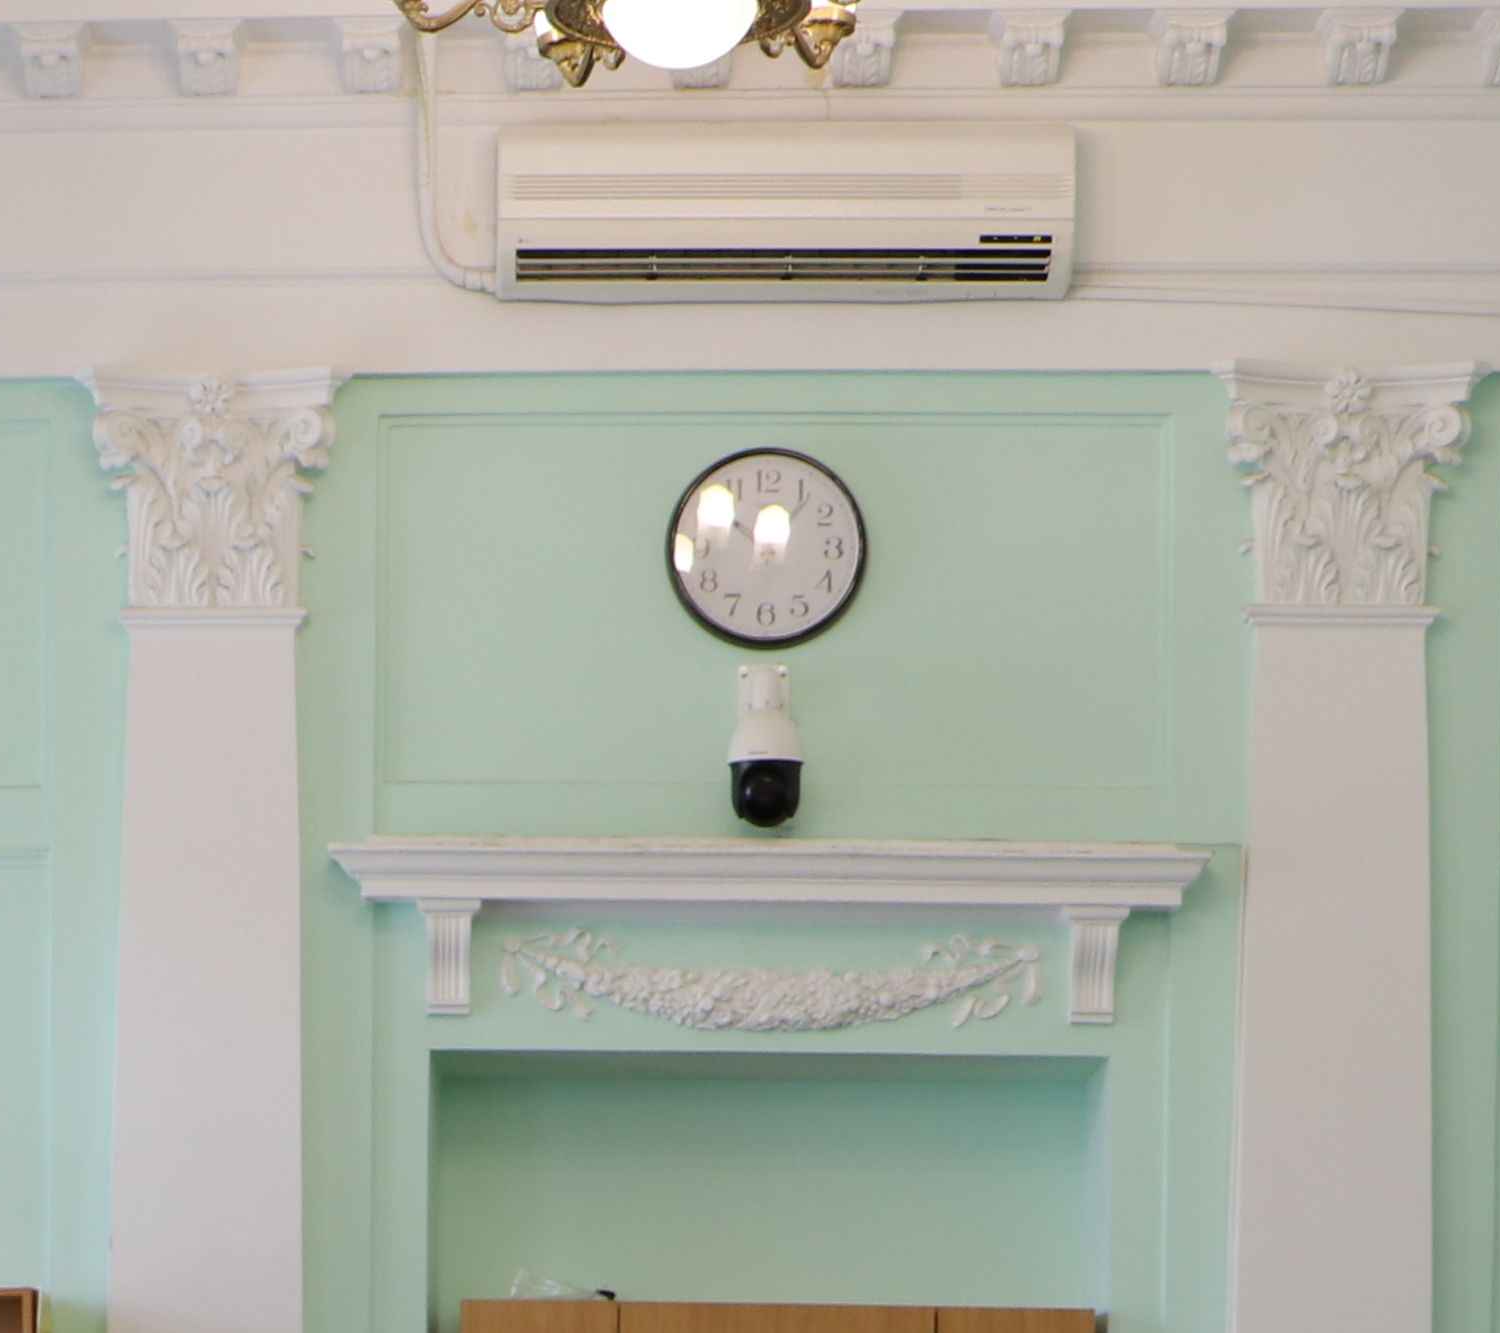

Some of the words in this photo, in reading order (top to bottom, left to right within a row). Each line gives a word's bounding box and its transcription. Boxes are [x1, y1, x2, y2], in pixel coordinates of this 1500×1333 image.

[756, 469, 782, 493] 12
[816, 503, 834, 527] 2
[823, 536, 844, 560] 3
[699, 569, 718, 592] 8
[814, 569, 833, 593] 4
[723, 593, 742, 617] 7
[756, 602, 776, 626] 6
[789, 595, 809, 618] 5
